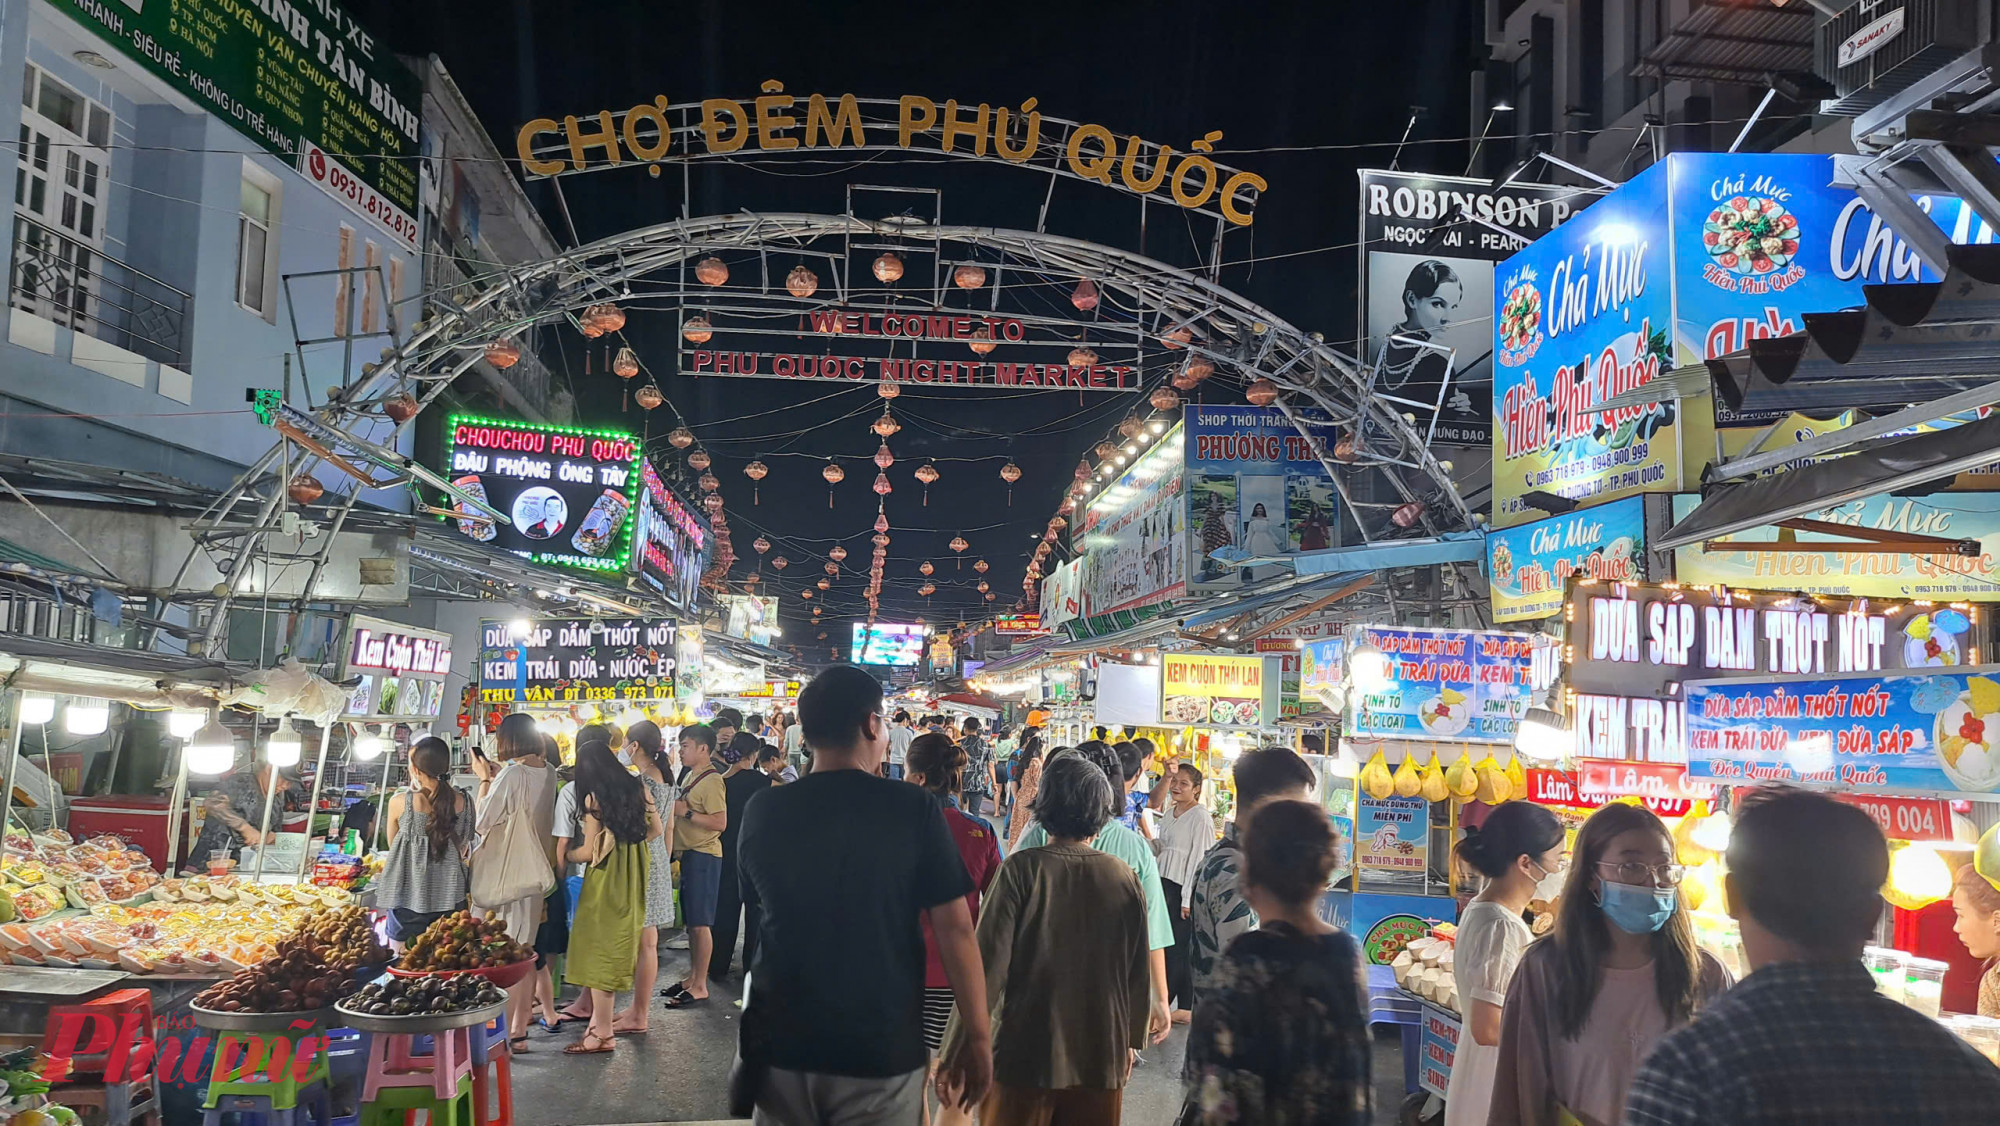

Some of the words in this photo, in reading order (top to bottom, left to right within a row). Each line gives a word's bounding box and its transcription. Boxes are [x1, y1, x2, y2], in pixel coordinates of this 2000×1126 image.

[346, 17, 374, 62] XE
[1857, 21, 1892, 49] SANAKY
[134, 29, 163, 64] SIÊU
[165, 51, 181, 78] RẺ
[190, 70, 229, 110] KHÔNG
[231, 104, 244, 121] LO
[246, 110, 265, 136] TRỄ
[267, 123, 294, 154] HÀNG
[268, 30, 294, 63] VẬN
[298, 58, 346, 106] CHUYỂN
[347, 100, 378, 134] HÀNG
[381, 127, 401, 152] HÓA
[315, 29, 365, 96] TÂN
[369, 78, 419, 143] BÌNH
[516, 94, 671, 178] CHỢ
[700, 79, 866, 154] ĐÊM
[899, 94, 1041, 164] PHÚ
[1067, 130, 1268, 226] QUỐC
[1711, 173, 1745, 201] Chả
[1749, 175, 1793, 202] Mực
[330, 167, 417, 243] 0931.812.812
[1369, 185, 1541, 229] ROBINSON
[1384, 225, 1426, 247] NGỌC
[1503, 269, 1519, 298] Chả
[1548, 244, 1590, 339] Chả
[1593, 238, 1649, 324] Mực
[1703, 263, 1738, 291] Hiền
[1739, 274, 1770, 295] Phú
[1769, 260, 1806, 292] Quốc
[810, 309, 972, 341] WELCOME
[984, 317, 1025, 342] TO
[693, 350, 758, 376] PHU
[772, 353, 865, 380] QUOC
[880, 358, 980, 385] NIGHT
[994, 363, 1131, 389] MARKET
[1198, 415, 1227, 426] SHOP
[1230, 411, 1256, 427] THỜI
[1502, 369, 1550, 462] Hiền
[1551, 352, 1595, 445] Phú
[455, 425, 545, 453] CHOUCHOU
[551, 435, 585, 457] PHÚ
[592, 434, 636, 462] QUỐC
[1196, 431, 1281, 461] PHƯƠNG
[1462, 429, 1485, 442] ĐẠO
[454, 451, 488, 474] ĐẬU
[495, 456, 551, 481] PHỘNG
[559, 461, 594, 484] ÔNG
[600, 465, 629, 487] TÂY
[1537, 469, 1553, 486] 0963
[1556, 466, 1569, 480] 718
[1571, 461, 1585, 477] 979
[1592, 455, 1612, 472] 0948
[1614, 449, 1630, 465] 900
[1632, 443, 1649, 460] 999
[1610, 476, 1621, 491] TP.
[1623, 470, 1639, 487] PHÚ
[1641, 458, 1665, 483] QUỐC
[1530, 522, 1562, 556] Chả
[1563, 517, 1604, 550] Mực
[1517, 559, 1553, 595] Hiền
[1587, 543, 1632, 580] Quốc
[486, 622, 514, 648] DỪA
[523, 622, 552, 648] SÁP
[560, 621, 591, 647] DẦM
[603, 621, 640, 647] THỐT
[648, 621, 676, 647] NỐT
[1593, 581, 1640, 662] DỪA
[1649, 591, 1695, 665] SÁP
[357, 630, 385, 667] Kem
[385, 634, 413, 677] Cuộn
[411, 639, 436, 673] Thái
[434, 642, 452, 674] Lan
[1382, 633, 1399, 652] SÁP
[1422, 634, 1447, 655] THỐT
[1447, 633, 1466, 656] NỐT
[1484, 636, 1501, 657] DỪA
[485, 660, 517, 681] KEM
[526, 655, 560, 680] TRÁI
[569, 654, 598, 679] DỪA
[610, 653, 649, 679] NƯỚC
[657, 652, 676, 678] ÉP
[1167, 662, 1187, 683] KEM
[1190, 659, 1216, 689] CUỘN
[1218, 660, 1239, 685] THÁI
[1242, 666, 1259, 686] LAN
[1400, 656, 1436, 681] TRÁI
[1439, 659, 1471, 683] DỪA
[1480, 664, 1512, 684] KEM
[481, 688, 516, 702] THU
[523, 685, 555, 702] VÂN
[586, 686, 616, 700] 0336
[624, 686, 647, 700] 973
[653, 686, 674, 699] 071
[1363, 693, 1384, 708] SINH
[1389, 689, 1404, 709] TỐ
[1484, 699, 1506, 712] SINH
[1510, 694, 1523, 713] TỐ
[1704, 692, 1731, 718] DỪA
[1734, 692, 1761, 718] SÁP
[1764, 687, 1798, 717] DẦM
[1803, 686, 1847, 718] THỐT
[1850, 683, 1890, 718] NỐT
[1359, 710, 1378, 728] CÁC
[1381, 715, 1405, 733] LOẠI
[1482, 714, 1500, 731] CÁC
[1576, 694, 1626, 760] KEM
[1691, 730, 1719, 750] KEM
[1724, 726, 1755, 751] TRÁI
[1877, 723, 1914, 754] SÁP
[1610, 767, 1669, 795] Lâm
[1709, 759, 1740, 778] Độc
[1840, 761, 1888, 784] Quốc
[1537, 773, 1574, 801] Lâm
[1397, 811, 1412, 823] PHÍ
[1564, 811, 1585, 822] Oanh
[1897, 804, 1936, 834] 004
[1428, 1042, 1445, 1064] KEM
[1427, 1068, 1446, 1091] SINH
